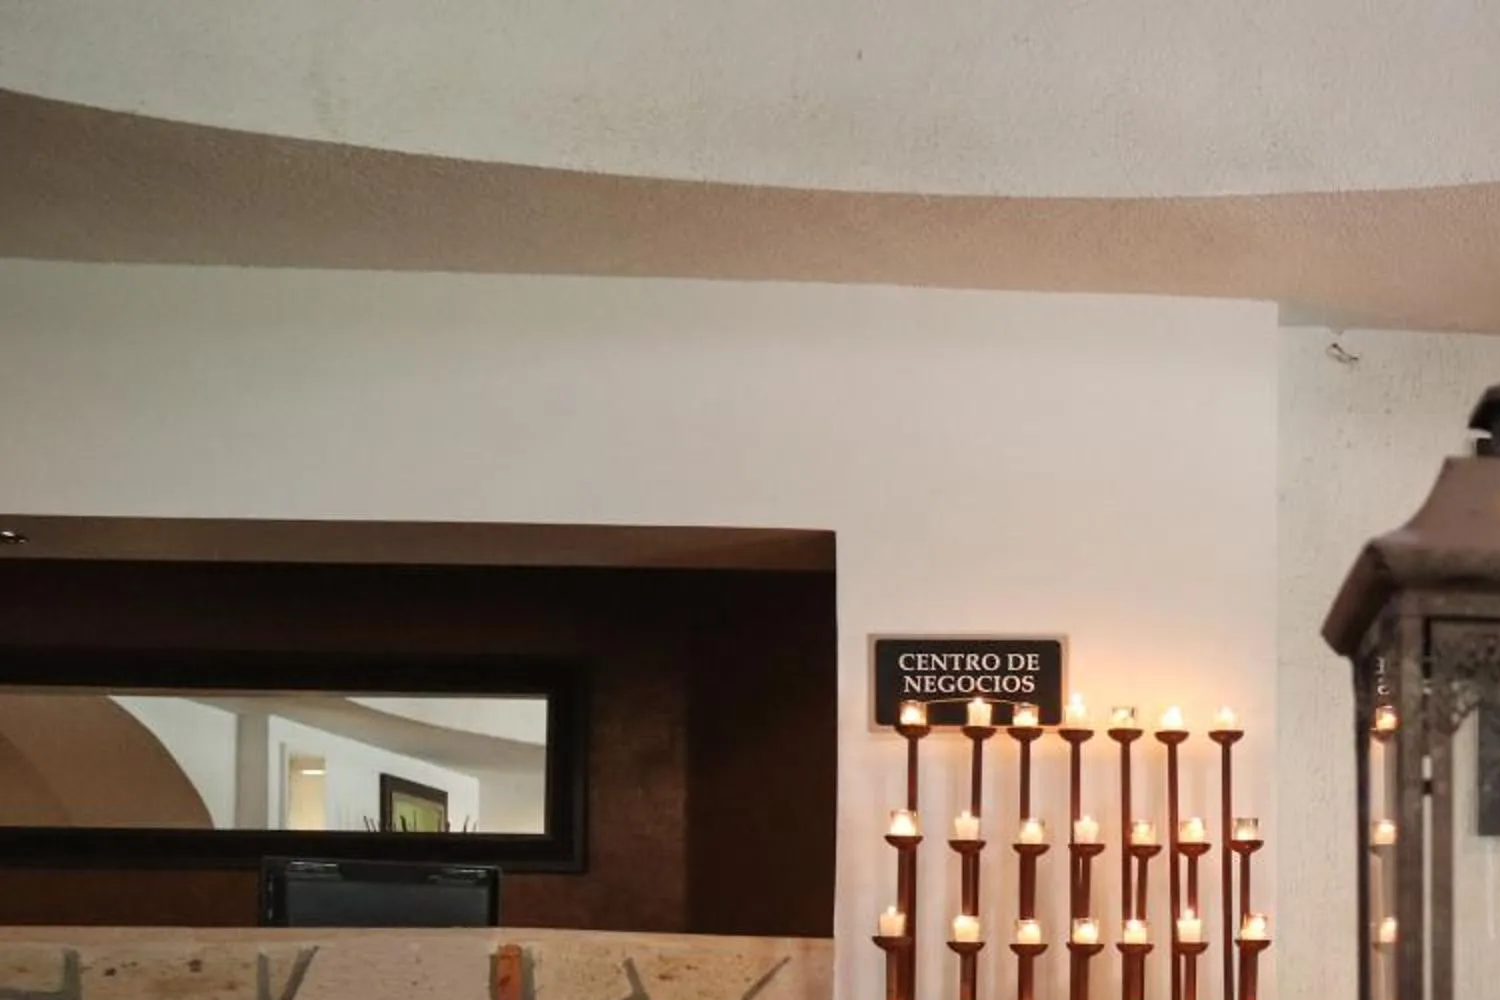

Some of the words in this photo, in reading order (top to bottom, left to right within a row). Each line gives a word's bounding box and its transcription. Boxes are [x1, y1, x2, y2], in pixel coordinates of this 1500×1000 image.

[899, 653, 1000, 671] CENTRO
[1007, 653, 1041, 671] DE
[903, 675, 1036, 693] NEGOCIOS
